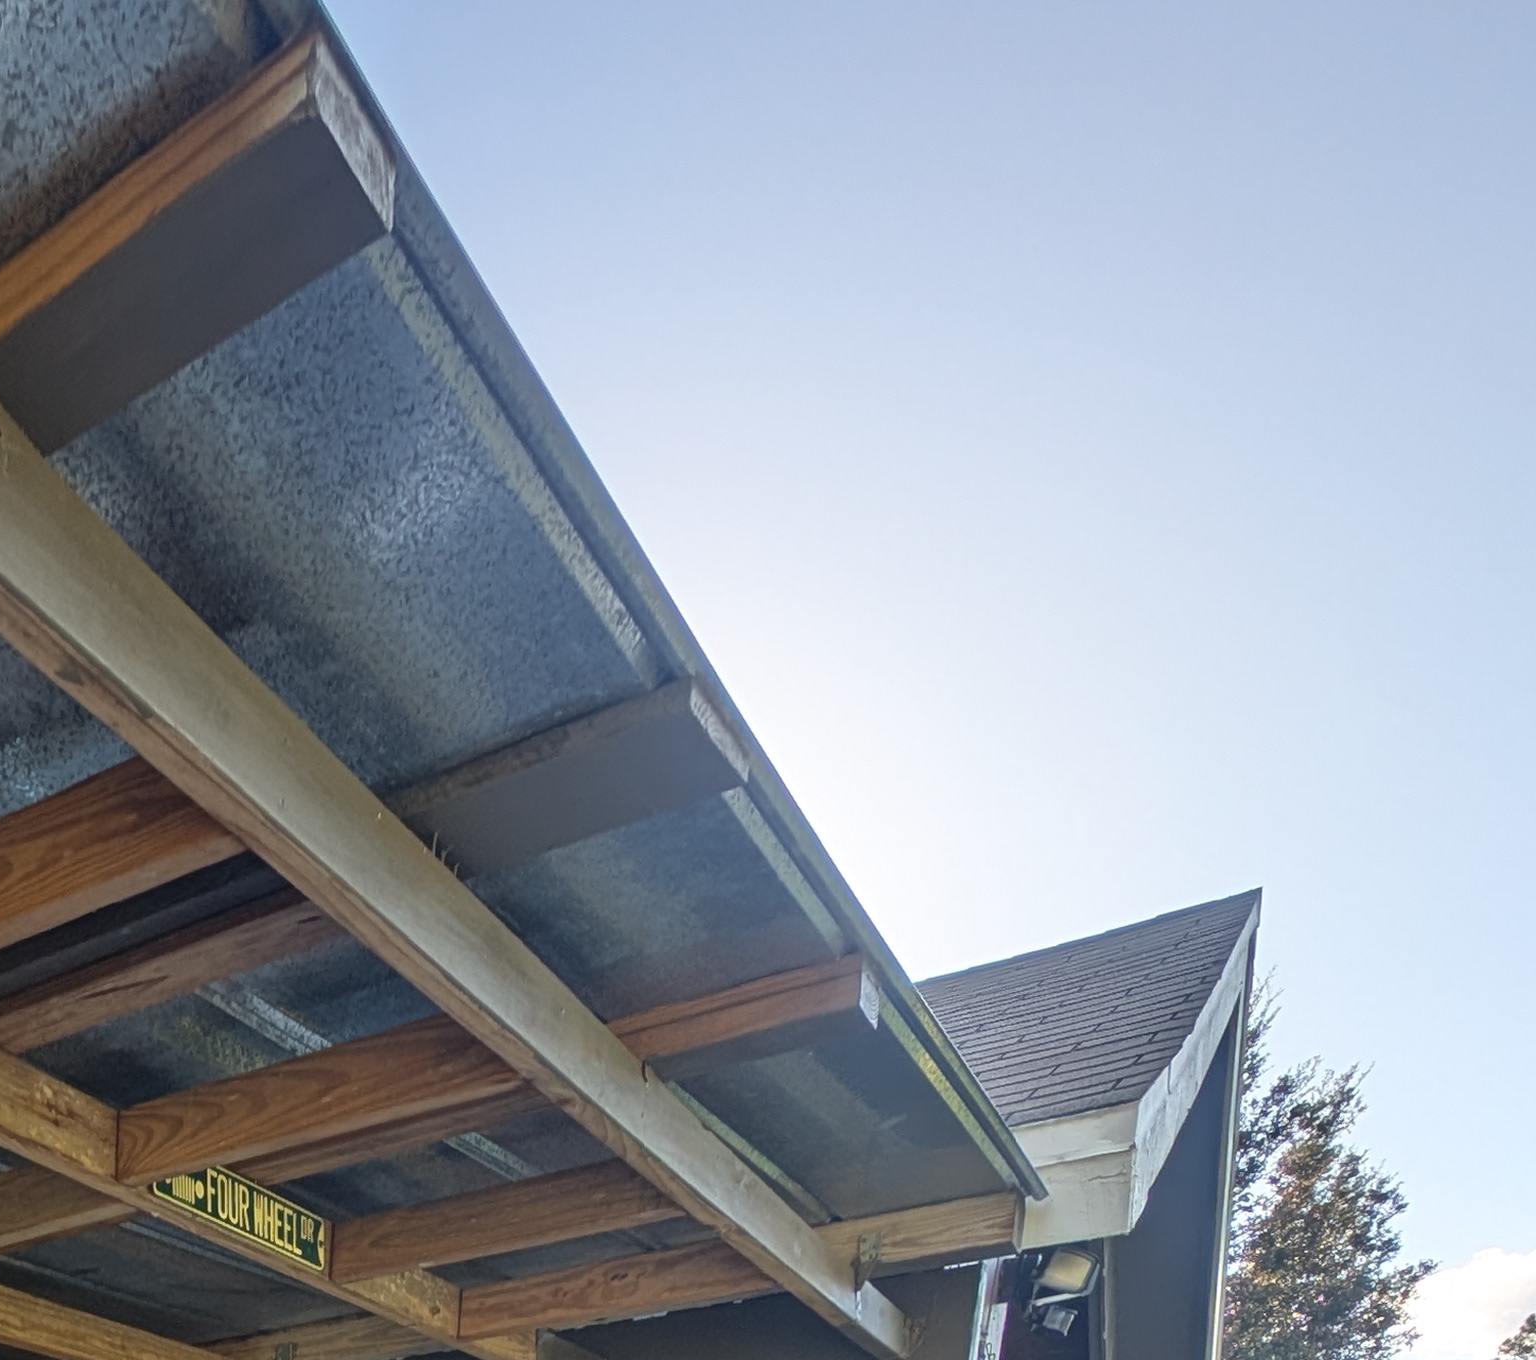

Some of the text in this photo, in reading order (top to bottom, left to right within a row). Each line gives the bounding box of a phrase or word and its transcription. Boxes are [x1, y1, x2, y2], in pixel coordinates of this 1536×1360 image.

[206, 1168, 314, 1256] FOUR WHEEL DR
